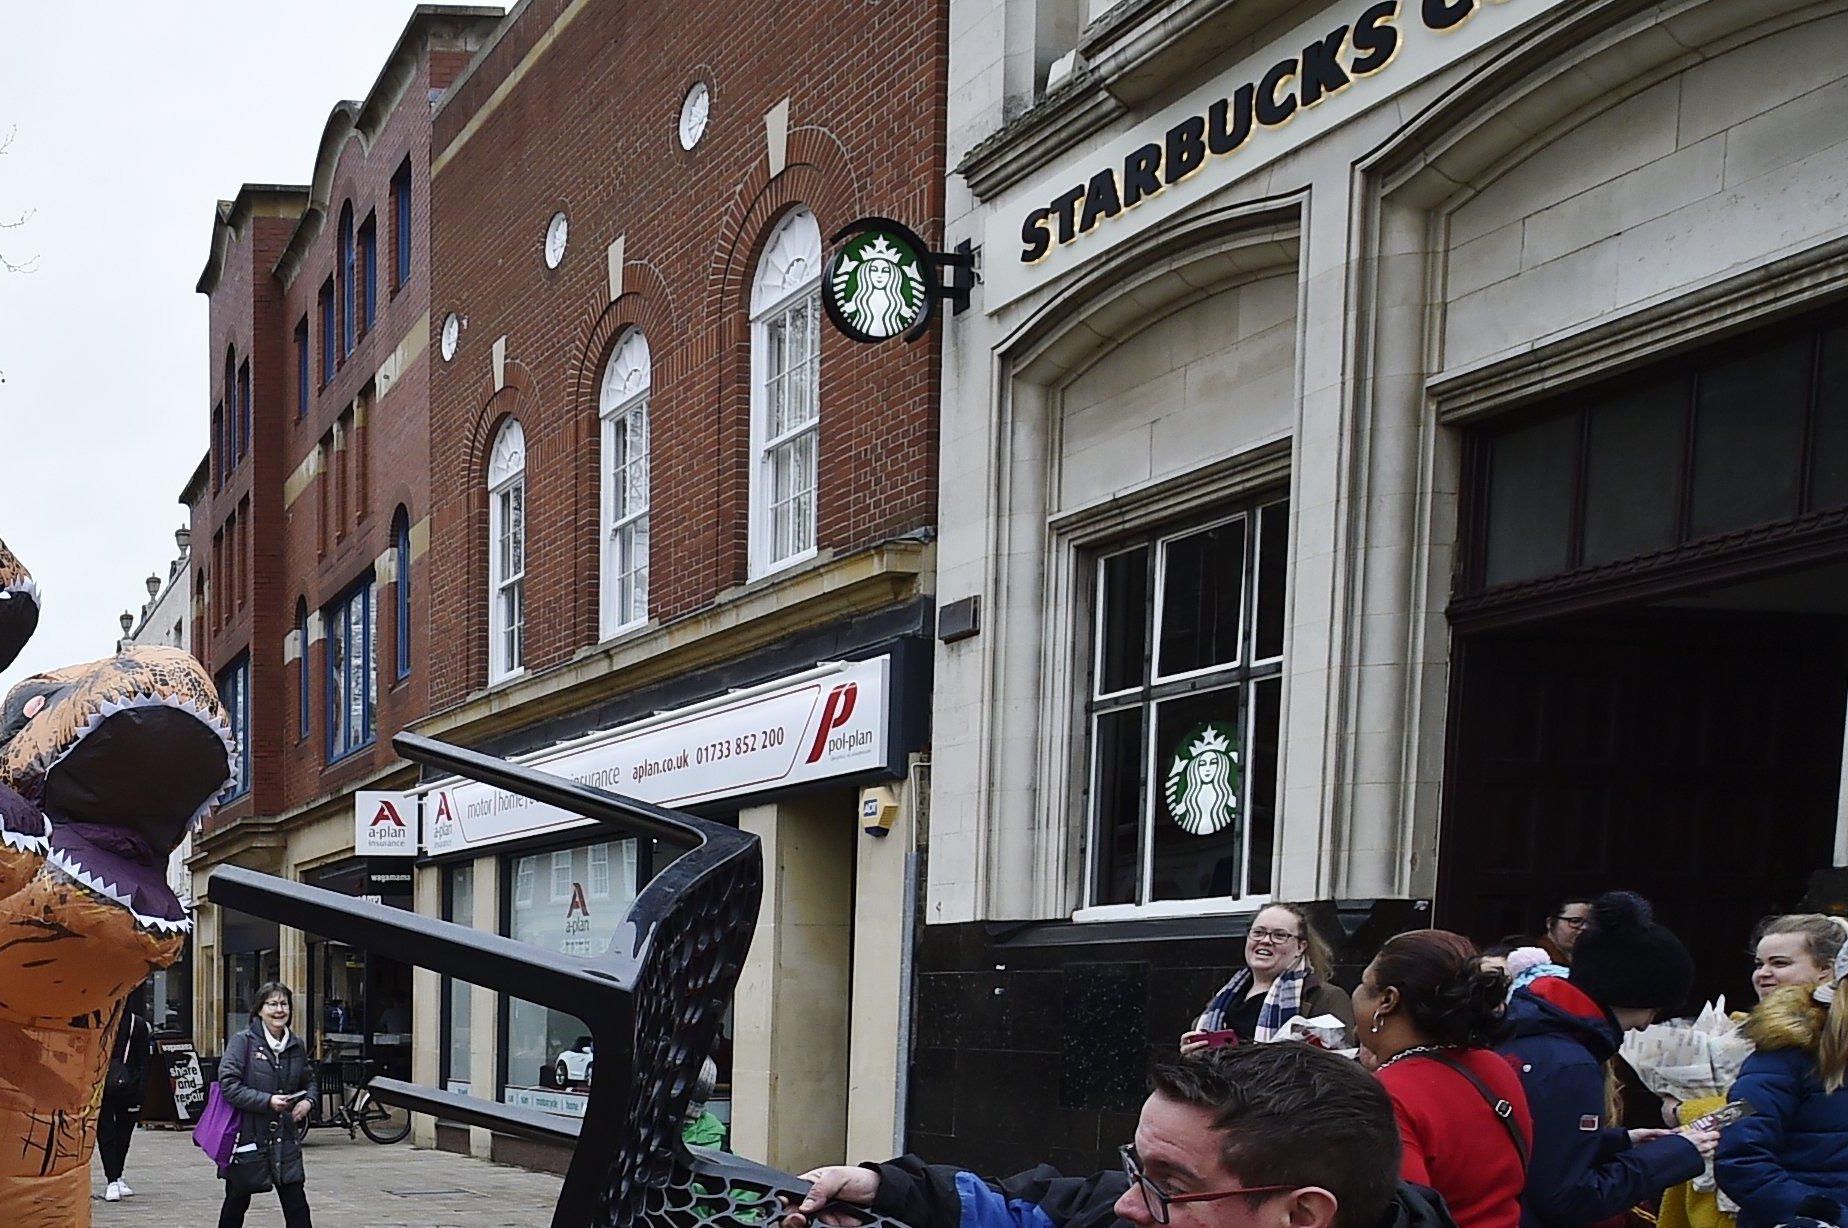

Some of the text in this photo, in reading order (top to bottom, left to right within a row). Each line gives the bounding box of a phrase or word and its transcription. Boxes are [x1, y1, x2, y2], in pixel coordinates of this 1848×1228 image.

[1021, 0, 1398, 263] STARBUCKS
[828, 729, 873, 755] pol-plan
[467, 799, 493, 819] motor
[632, 750, 689, 783] aplan.co.uk
[696, 740, 731, 765] 01733
[735, 734, 757, 756] 852
[761, 726, 784, 751] 200
[368, 825, 406, 840] a-plan
[169, 1065, 198, 1077] share
[177, 1077, 196, 1089] and
[174, 1090, 205, 1105] repair
